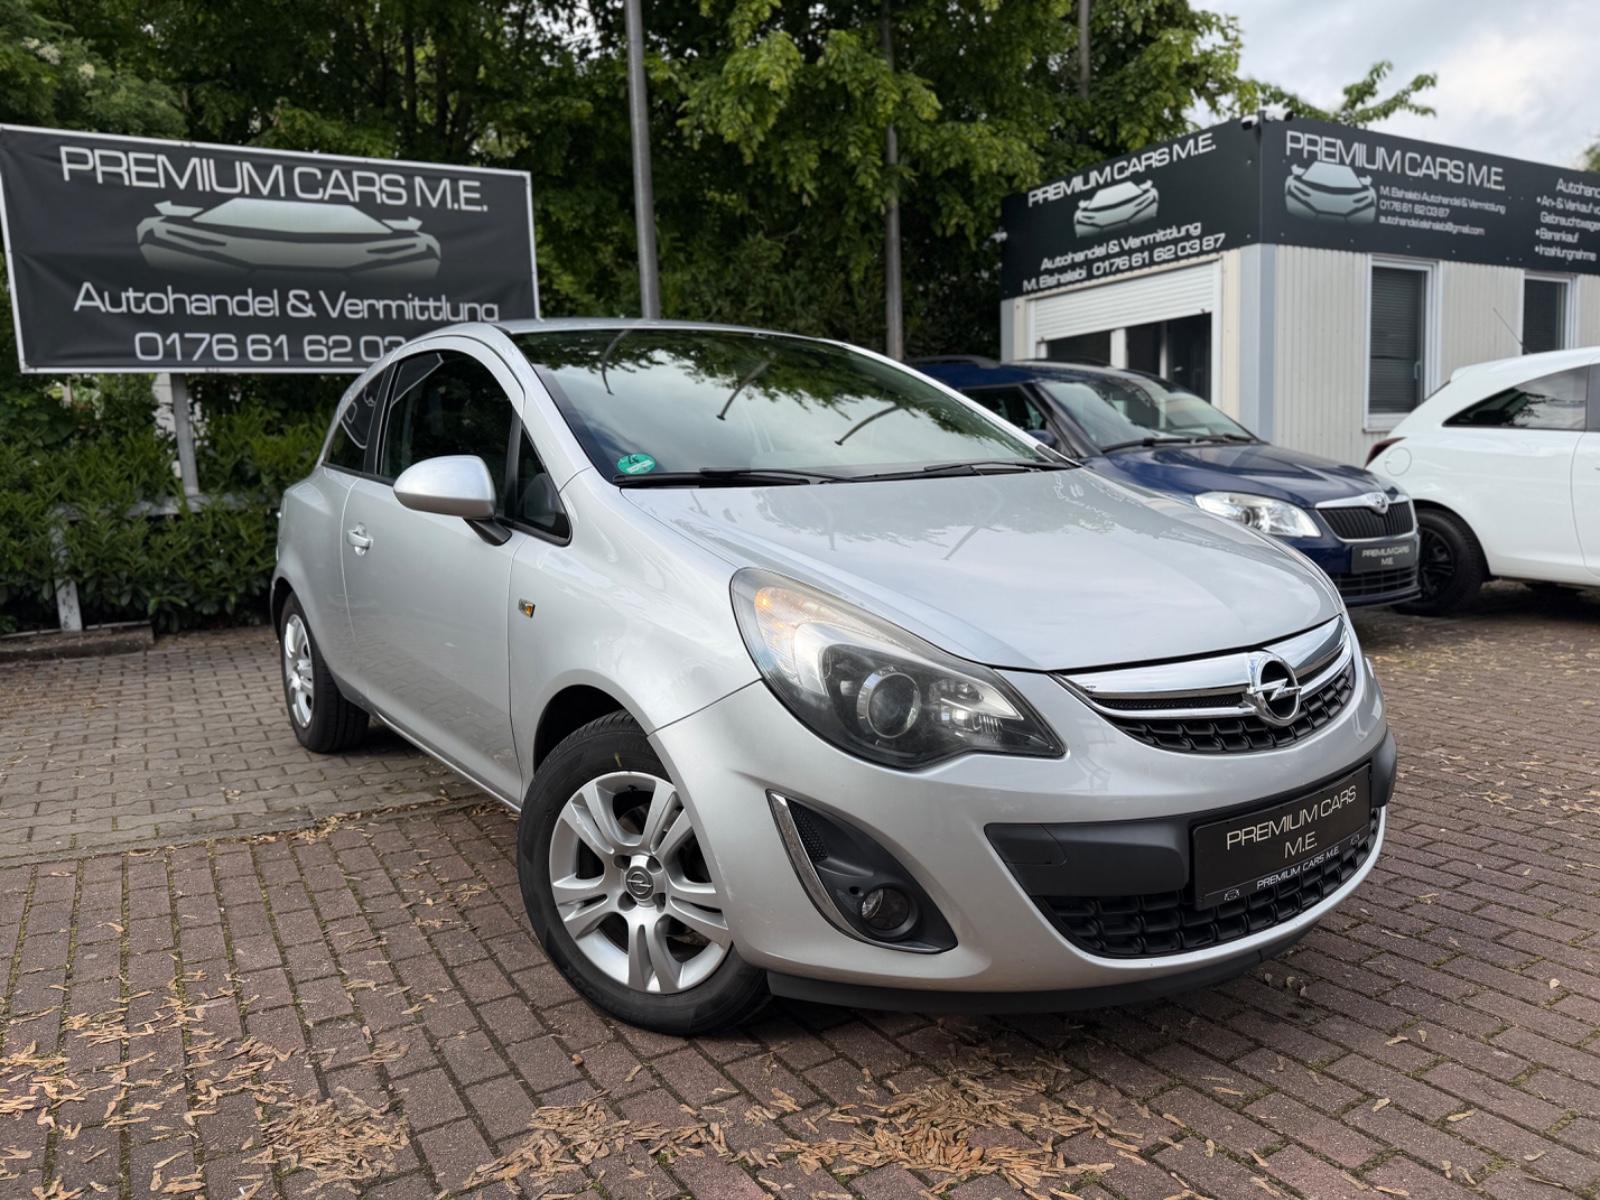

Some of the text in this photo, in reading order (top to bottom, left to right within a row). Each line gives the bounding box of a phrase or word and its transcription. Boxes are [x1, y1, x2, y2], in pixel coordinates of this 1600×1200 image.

[59, 146, 489, 213] PREMIUM CARS M.E.
[1028, 133, 1217, 208] PREMIUM CARS M.E.
[1286, 130, 1506, 191] PREMIUM CARS M.E.
[1380, 199, 1401, 213] 0176
[1022, 278, 1038, 293] M.
[1092, 258, 1130, 276] 0176
[1131, 251, 1149, 267] 61
[1153, 245, 1175, 262] 62
[1176, 239, 1200, 256] 03
[1202, 233, 1226, 250] 87
[1040, 222, 1201, 271] Autohandel & Vermittlung
[73, 281, 499, 322] Autohandel & Vermittlung
[134, 331, 239, 362] 0176
[247, 334, 289, 362] 61
[303, 334, 353, 362] 62
[1226, 785, 1357, 850] PREMIUM CARS
[1284, 831, 1318, 859] M.E.
[1256, 864, 1300, 890] PREMIUM
[1302, 854, 1324, 871] CARS
